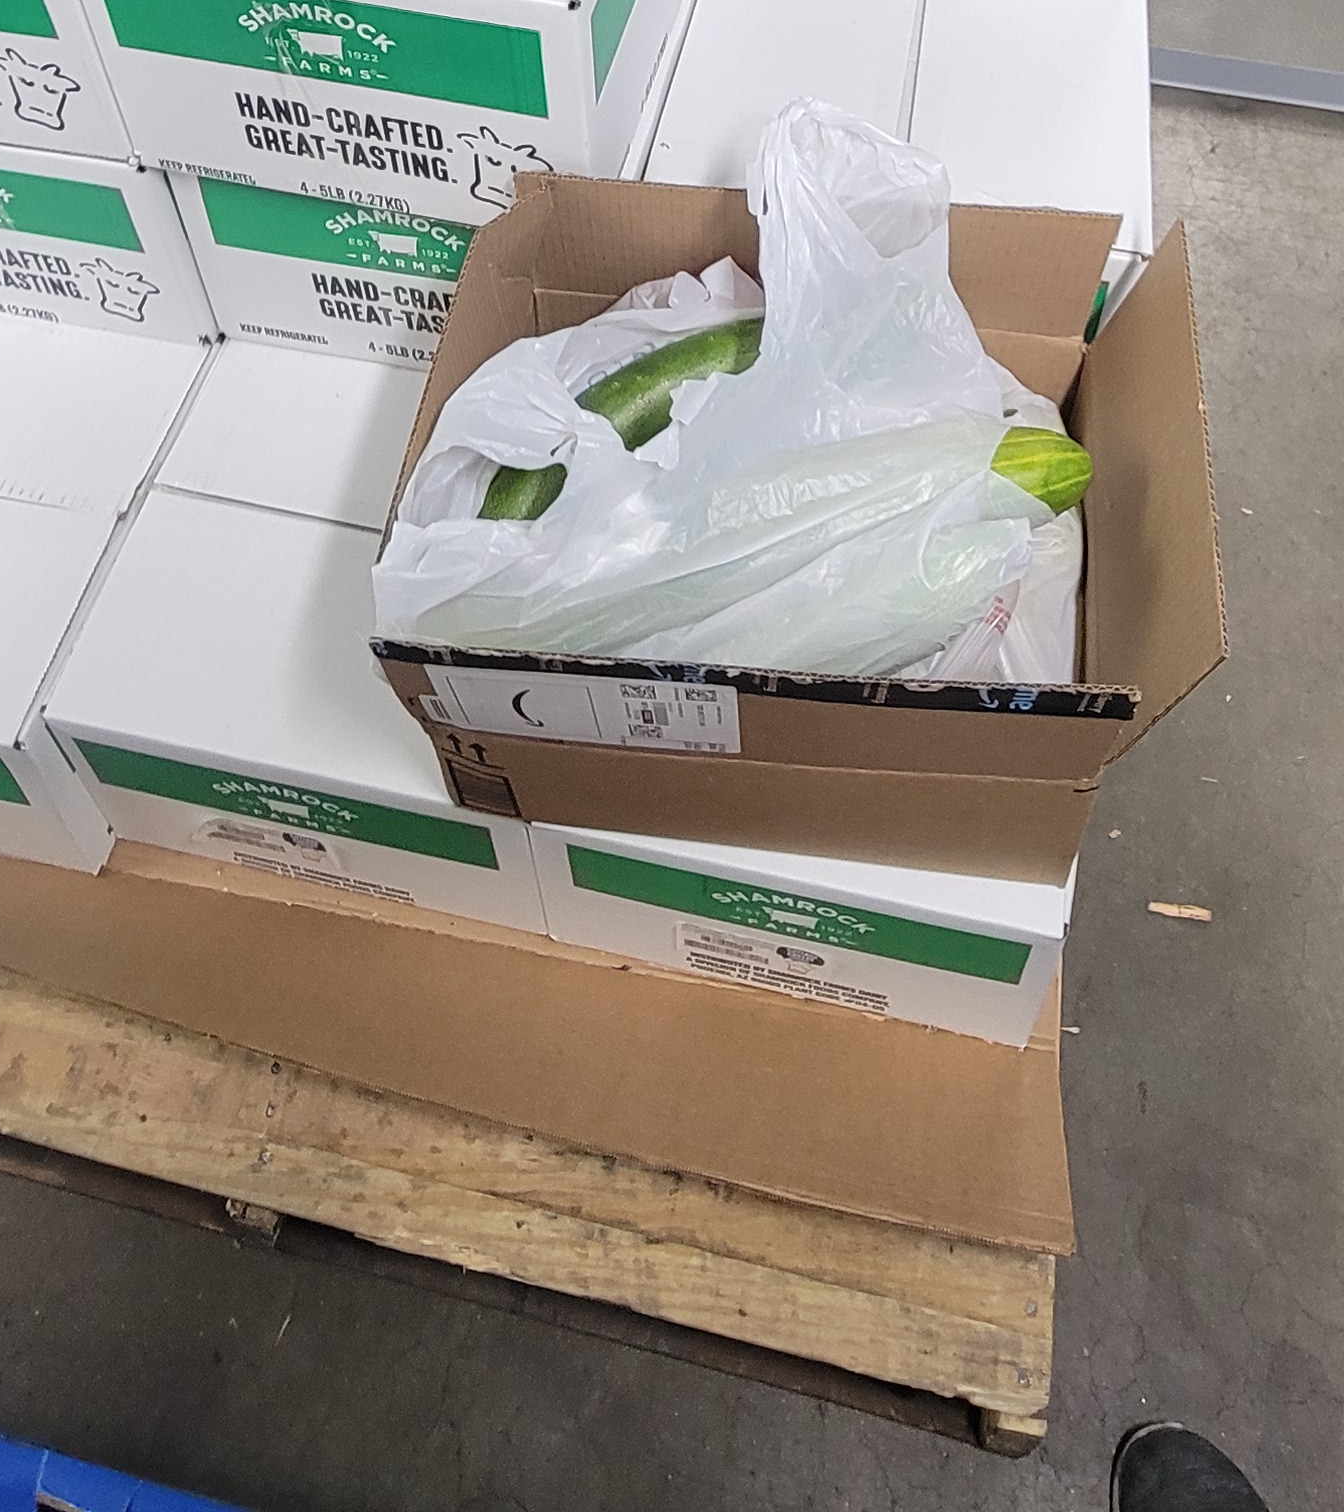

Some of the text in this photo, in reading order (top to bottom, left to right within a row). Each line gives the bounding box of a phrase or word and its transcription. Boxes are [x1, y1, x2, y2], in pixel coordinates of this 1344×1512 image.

[237, 0, 398, 55] SHAMROCK
[234, 91, 455, 155] HAND-CRAFTED.
[158, 158, 183, 172] KEEP
[244, 123, 459, 185] GREAT-TASTING.
[324, 209, 467, 253] SHAMROCK
[362, 252, 444, 274] FARMS
[310, 272, 454, 314] HAND-CRAF
[318, 297, 447, 336] GREAT-TAS
[211, 779, 359, 822] SHAMROCK
[711, 890, 876, 935] SHAMROCK
